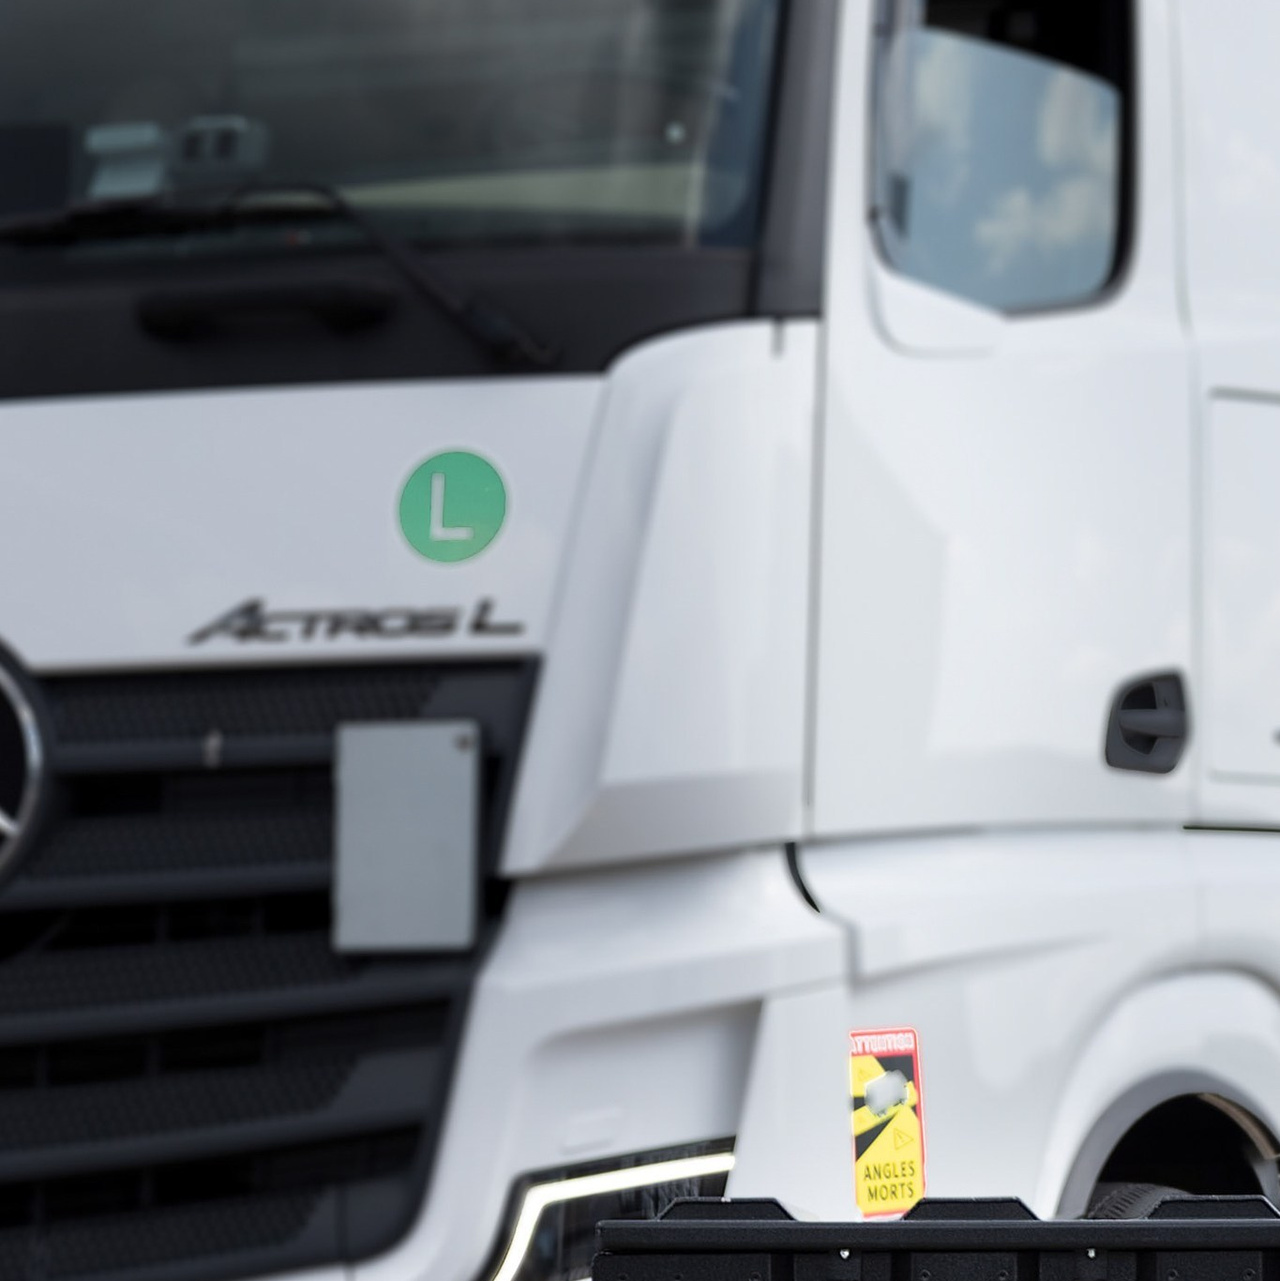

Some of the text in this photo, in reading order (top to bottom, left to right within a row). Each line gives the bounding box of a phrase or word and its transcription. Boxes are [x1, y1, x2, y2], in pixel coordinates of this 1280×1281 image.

[429, 471, 475, 542] L
[468, 596, 526, 637] L
[864, 1161, 915, 1181] ANGLES
[867, 1182, 914, 1202] MORTS
